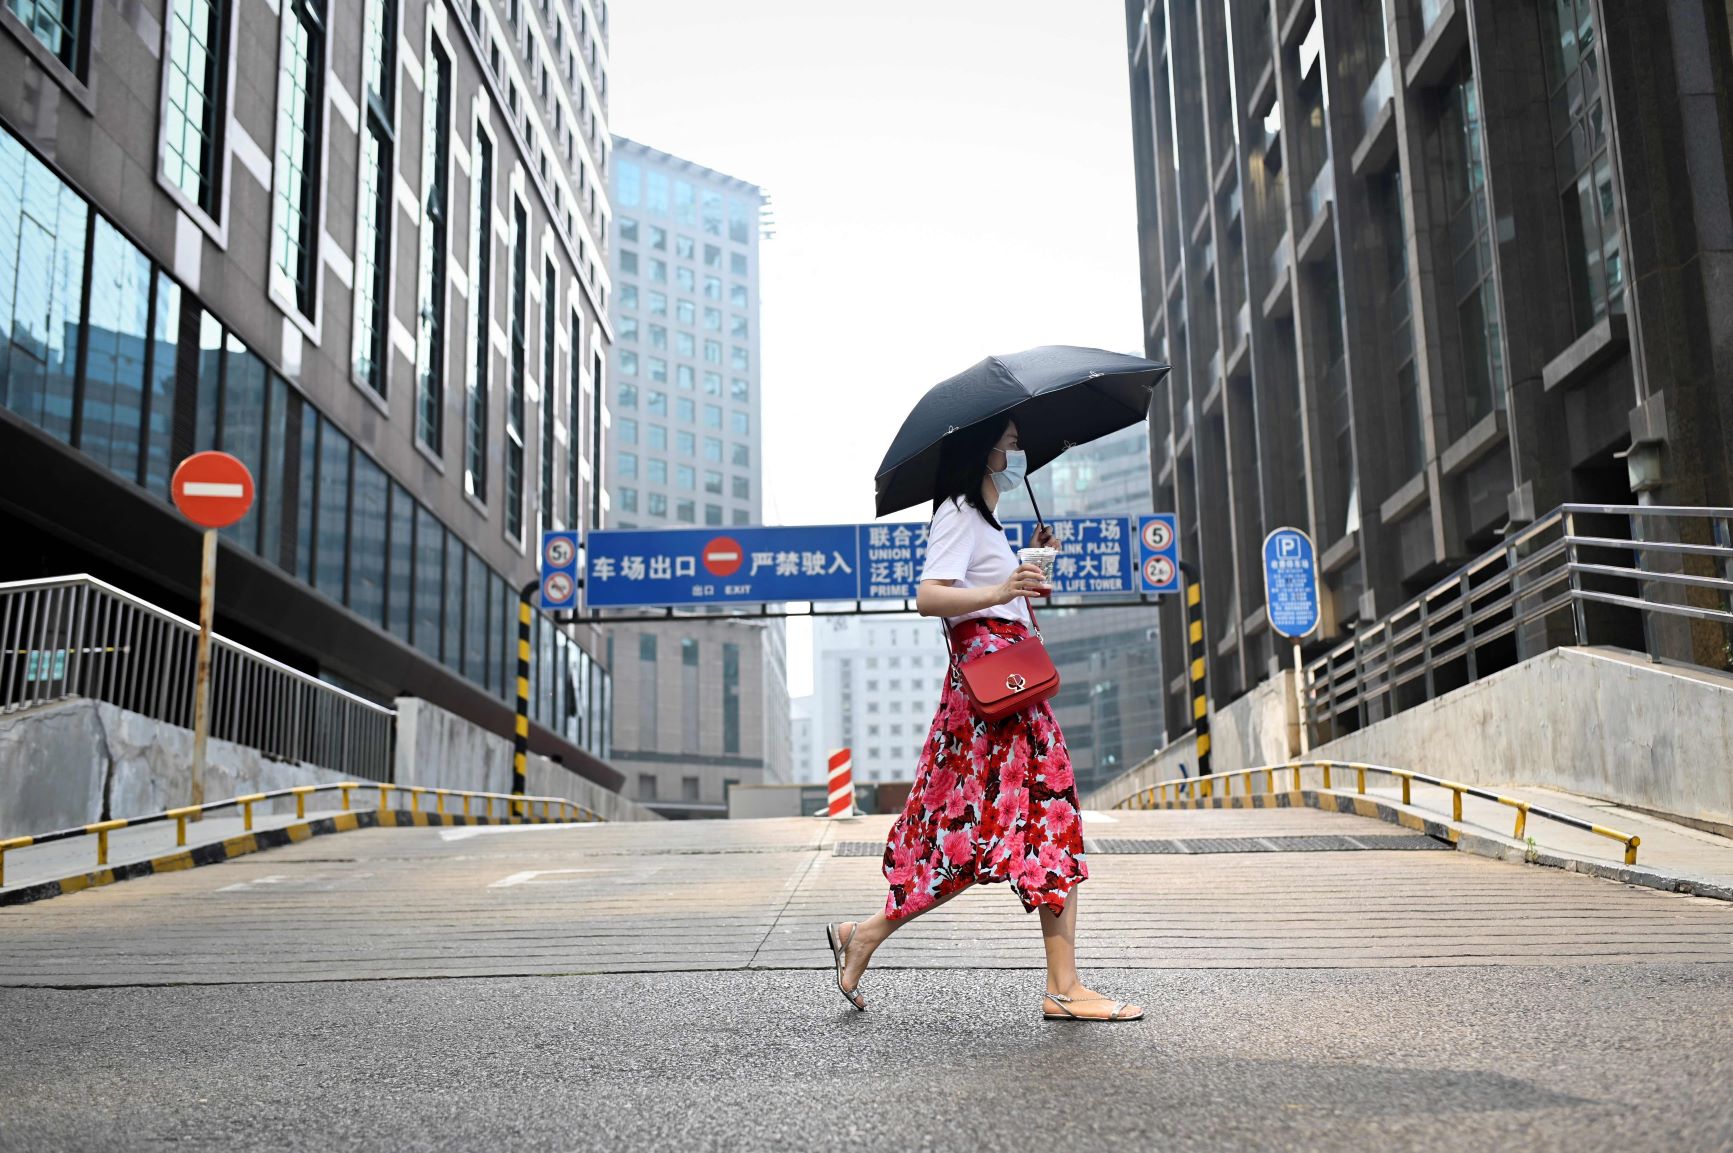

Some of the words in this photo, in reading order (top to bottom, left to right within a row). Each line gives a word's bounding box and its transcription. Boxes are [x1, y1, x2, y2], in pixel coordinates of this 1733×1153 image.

[1032, 520, 1120, 541] 联广场
[1153, 527, 1163, 544] 5
[552, 545, 567, 561] 5t
[869, 548, 911, 560] UNION
[1087, 542, 1121, 554] PLAZA
[1282, 539, 1295, 556] P
[592, 554, 696, 581] 车场出口
[750, 550, 852, 577] 严禁驶入
[692, 585, 714, 596] 出口
[725, 584, 751, 596] EXIT
[870, 584, 909, 597] PRIME
[1066, 579, 1086, 591] LIFE
[1089, 578, 1122, 591] TOWER
